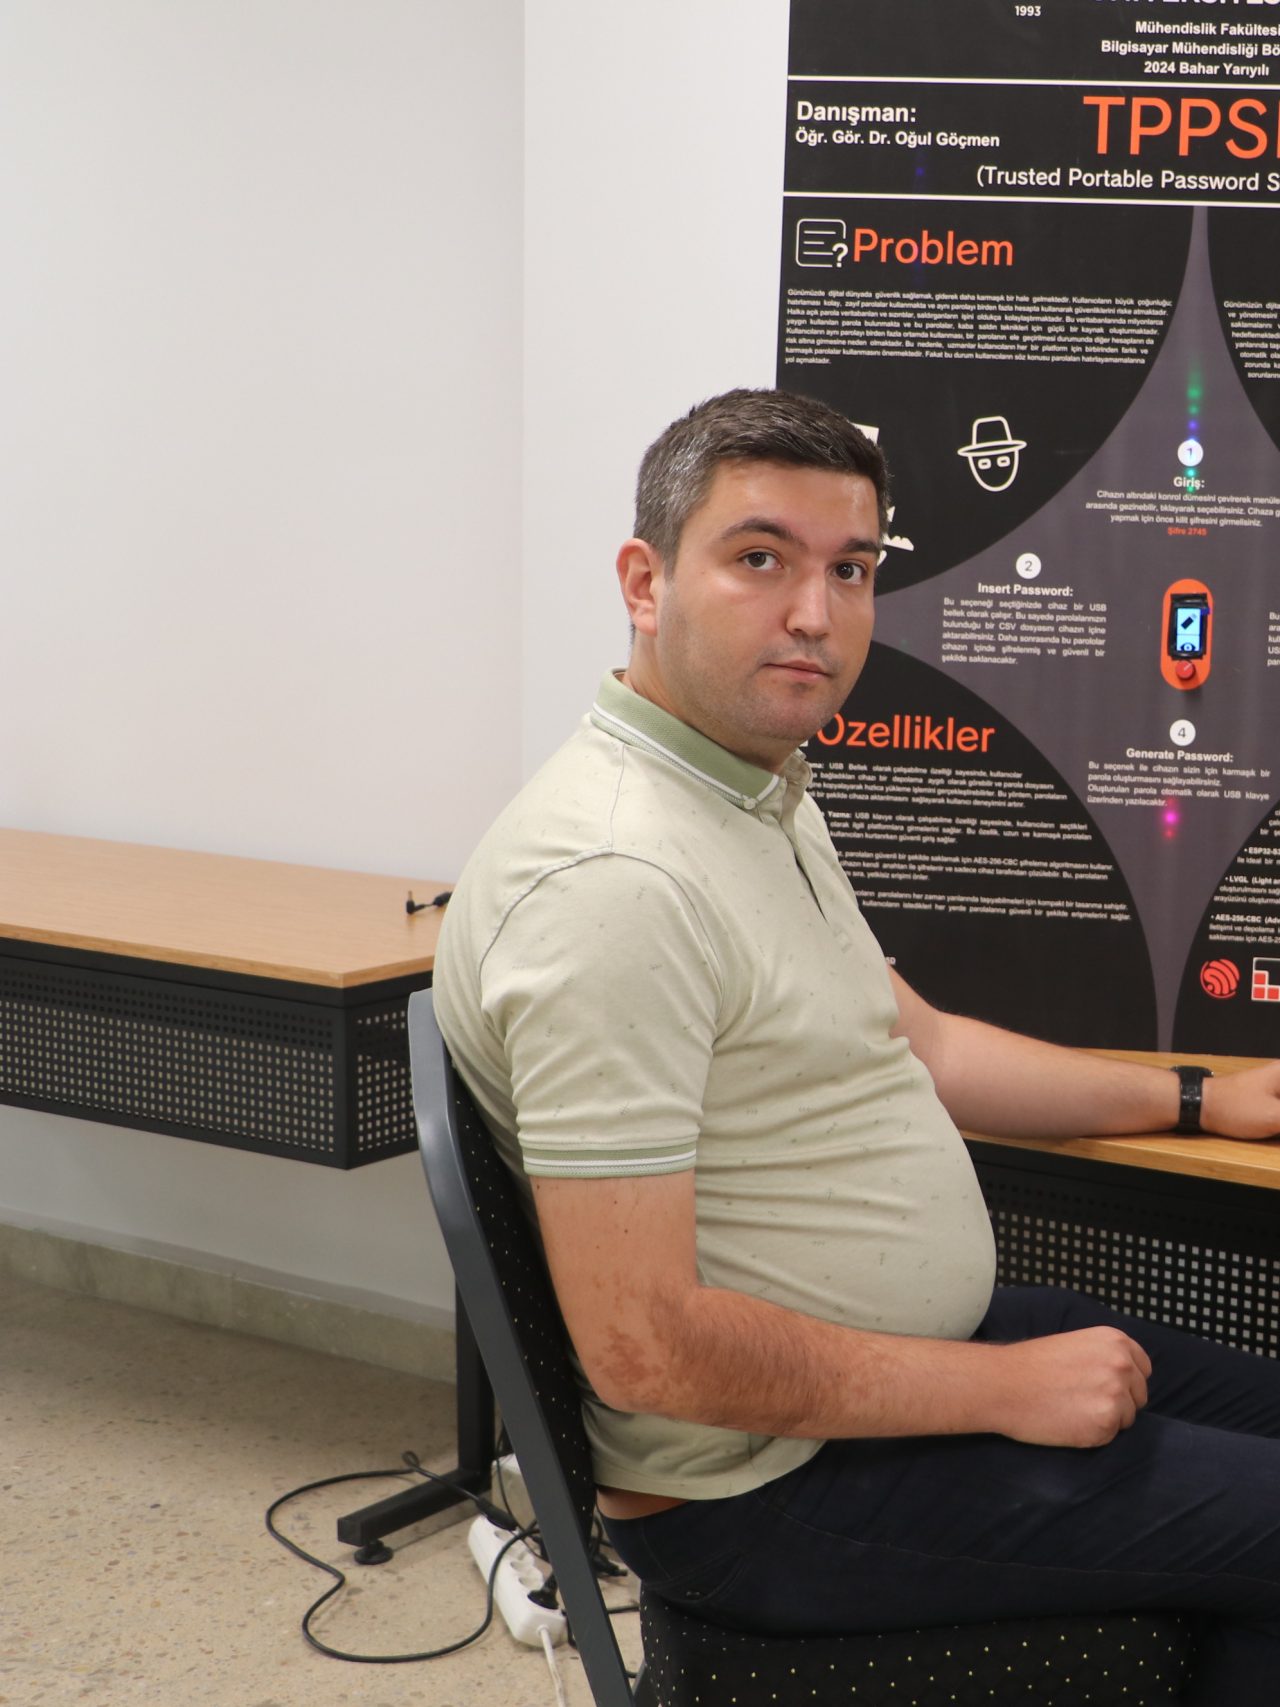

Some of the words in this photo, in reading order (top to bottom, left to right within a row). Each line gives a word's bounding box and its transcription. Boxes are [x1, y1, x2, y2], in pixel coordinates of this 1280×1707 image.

[1015, 5, 1041, 16] 1993
[1135, 21, 1216, 34] Mühendislik
[1220, 23, 1280, 35] Fakültesi
[1101, 40, 1168, 55] Bilgisayar
[1171, 41, 1257, 57] Mühendisliği
[1143, 61, 1175, 73] 2024
[1179, 61, 1220, 74] Bahar
[1222, 63, 1269, 77] Yarıyılı
[796, 101, 915, 124] Danışman:
[795, 128, 827, 145] Öğr.
[832, 129, 864, 143] Gör.
[868, 130, 890, 144] Dr.
[894, 131, 931, 147] Oğul
[935, 132, 999, 148] Göçmen
[976, 165, 1060, 185] (Trusted
[1068, 168, 1152, 187] Portable
[1160, 170, 1259, 190] Password
[853, 229, 1013, 265] Problem
[1173, 476, 1204, 489] Giriş:
[1024, 560, 1033, 572] 2
[977, 583, 1010, 593] Insert
[1013, 584, 1073, 596] Password:
[1177, 727, 1186, 738] 4
[1125, 748, 1174, 759] Generate
[1176, 750, 1233, 761] Password:
